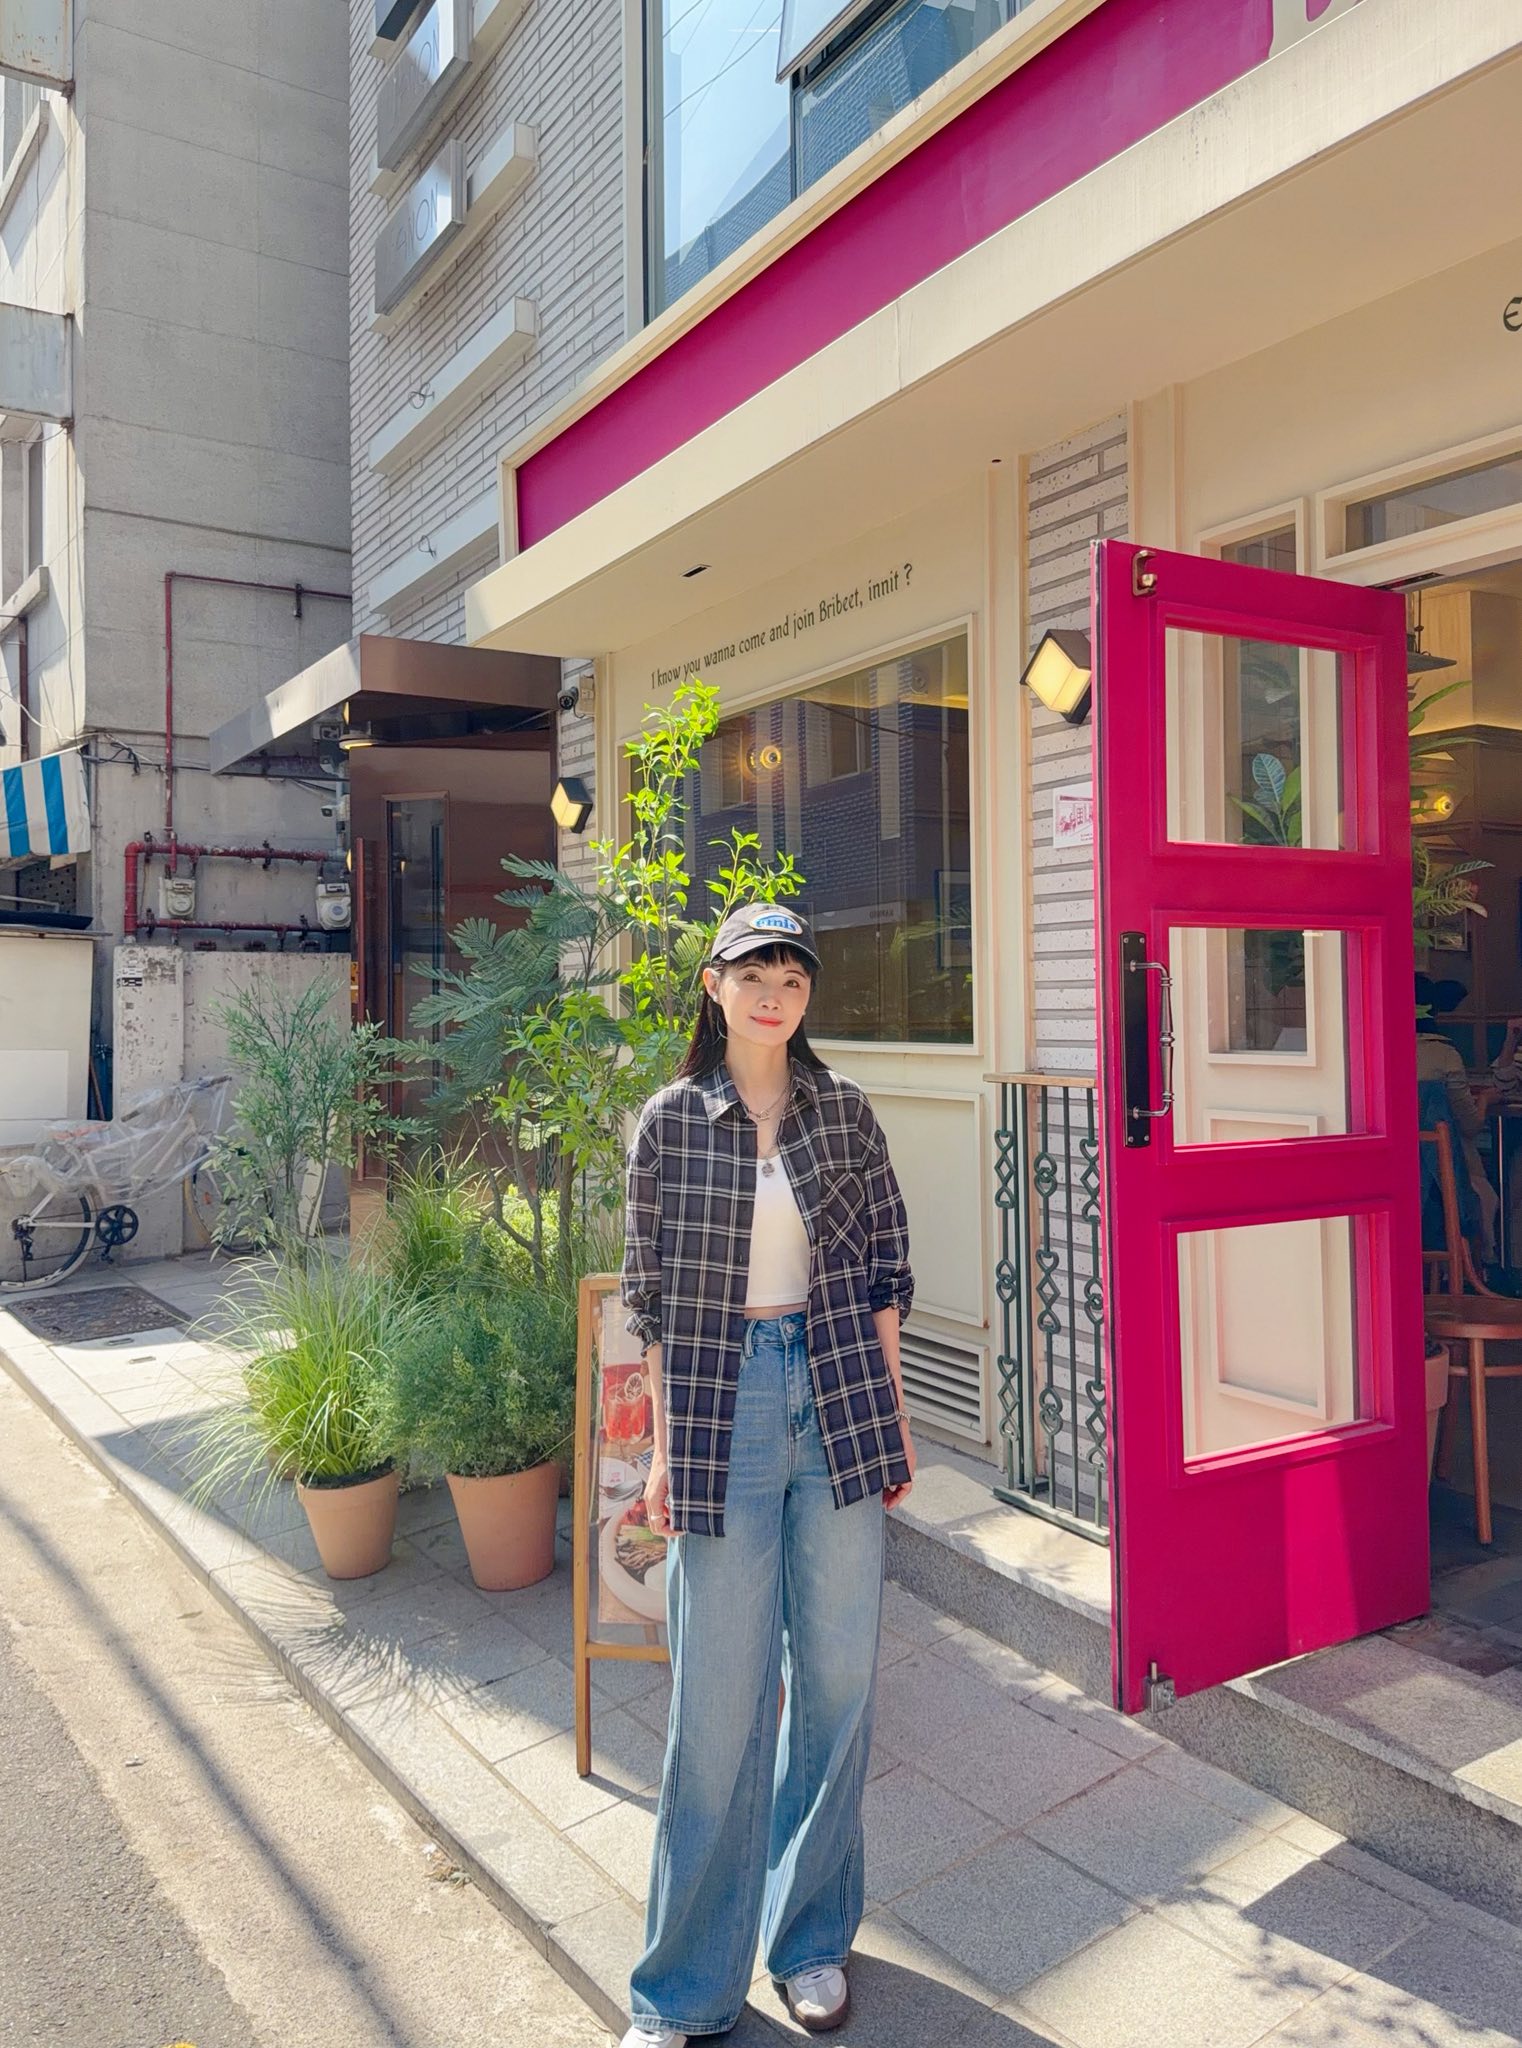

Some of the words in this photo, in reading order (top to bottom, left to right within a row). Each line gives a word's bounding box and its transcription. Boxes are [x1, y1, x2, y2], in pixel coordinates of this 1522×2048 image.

[651, 671, 656, 690] I
[657, 668, 681, 688] know
[683, 658, 701, 682] you
[703, 644, 736, 668] wanna
[738, 631, 766, 653] come
[769, 615, 789, 642] and
[793, 608, 815, 639] join
[819, 593, 863, 622] Bribeet,
[868, 571, 899, 601] innit
[903, 562, 914, 586] ?
